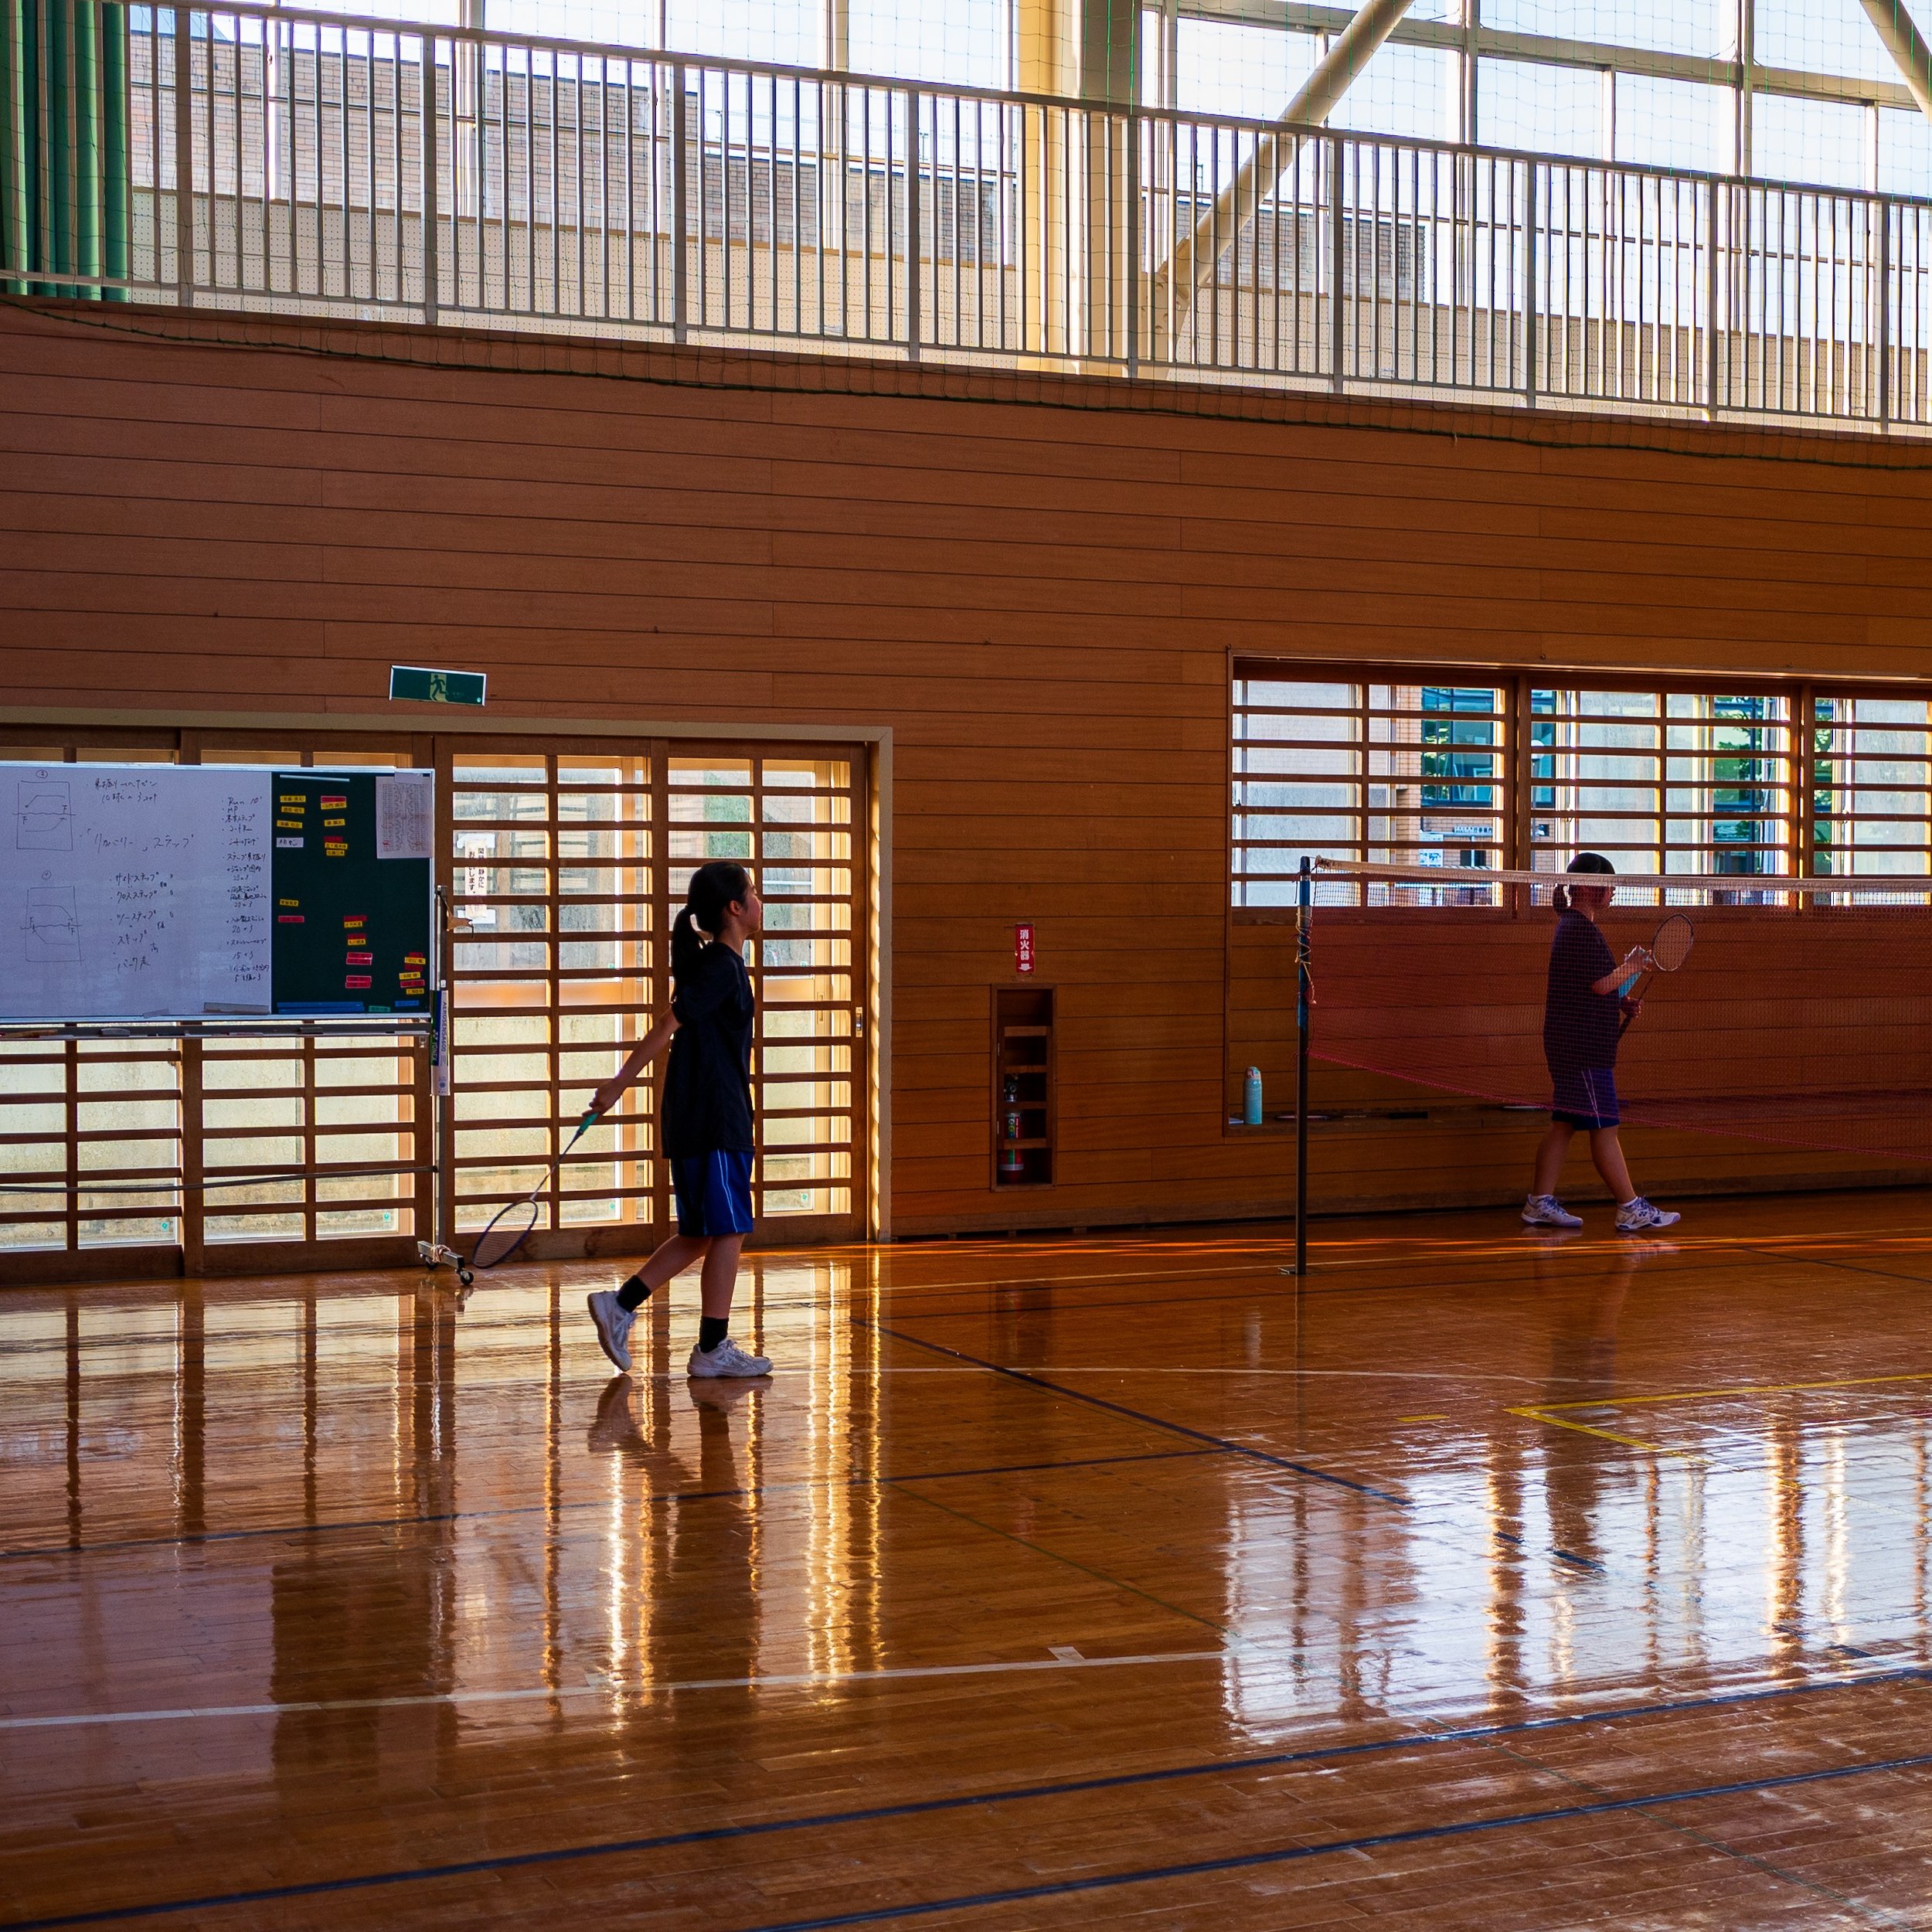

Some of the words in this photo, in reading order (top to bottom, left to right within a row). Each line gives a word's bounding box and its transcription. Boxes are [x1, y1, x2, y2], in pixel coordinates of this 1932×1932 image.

[228, 797, 245, 806] Run
[1019, 929, 1029, 961] 消火器
